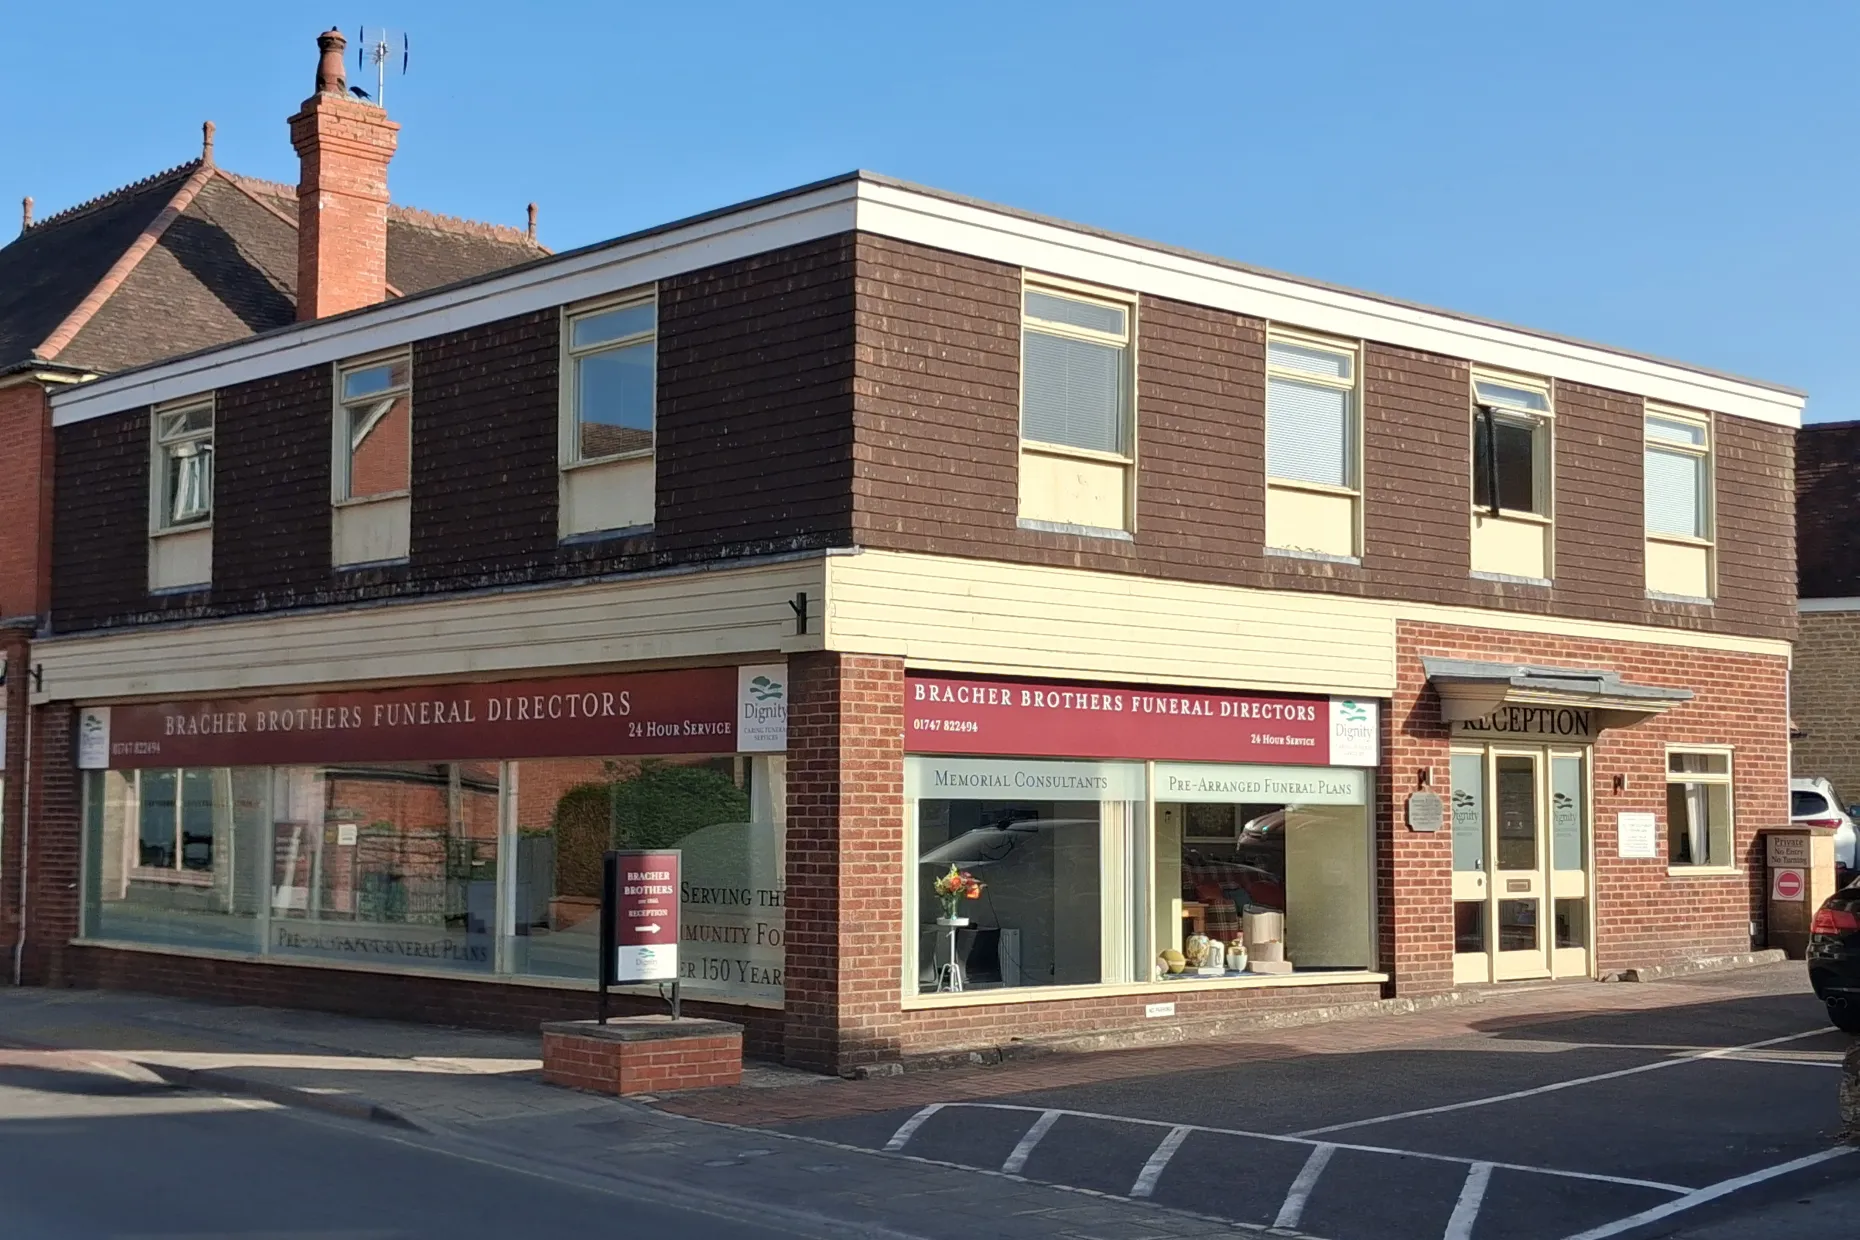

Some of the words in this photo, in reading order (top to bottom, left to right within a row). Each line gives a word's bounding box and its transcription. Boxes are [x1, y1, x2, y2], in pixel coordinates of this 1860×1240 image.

[914, 684, 1013, 706] BRACHER
[1021, 690, 1123, 712] BROTHERS
[1131, 696, 1213, 716] FUNERAL
[1220, 701, 1316, 721] DIRECTORS
[164, 712, 248, 736] BRACHER
[256, 706, 362, 732] BROTHERS
[373, 700, 476, 727] FUNERAL
[487, 691, 631, 721] DIRECTORS
[744, 702, 787, 724] Dignity
[628, 722, 643, 738] 24
[646, 721, 680, 737] HOUR
[683, 720, 732, 735] SERVICE
[913, 719, 941, 731] 01747
[943, 720, 979, 732] 822494
[1336, 723, 1372, 742] Dignity
[1250, 733, 1261, 744] 24
[1262, 734, 1284, 745] HOUR
[1285, 735, 1315, 747] SERVICE
[934, 769, 1010, 787] MEMORIAL
[1014, 771, 1108, 789] CONSULTANTS
[1169, 775, 1261, 793] PRE-ARRANGED
[1264, 778, 1316, 794] FUNERAL
[1318, 780, 1352, 796] PLANS
[1774, 837, 1804, 847] Private
[1771, 856, 1781, 864] No
[1786, 848, 1804, 857] Entry
[627, 871, 670, 881] BRACHER
[624, 885, 673, 895] BROTHERS
[681, 881, 752, 906] SERVING
[702, 957, 731, 982] 150
